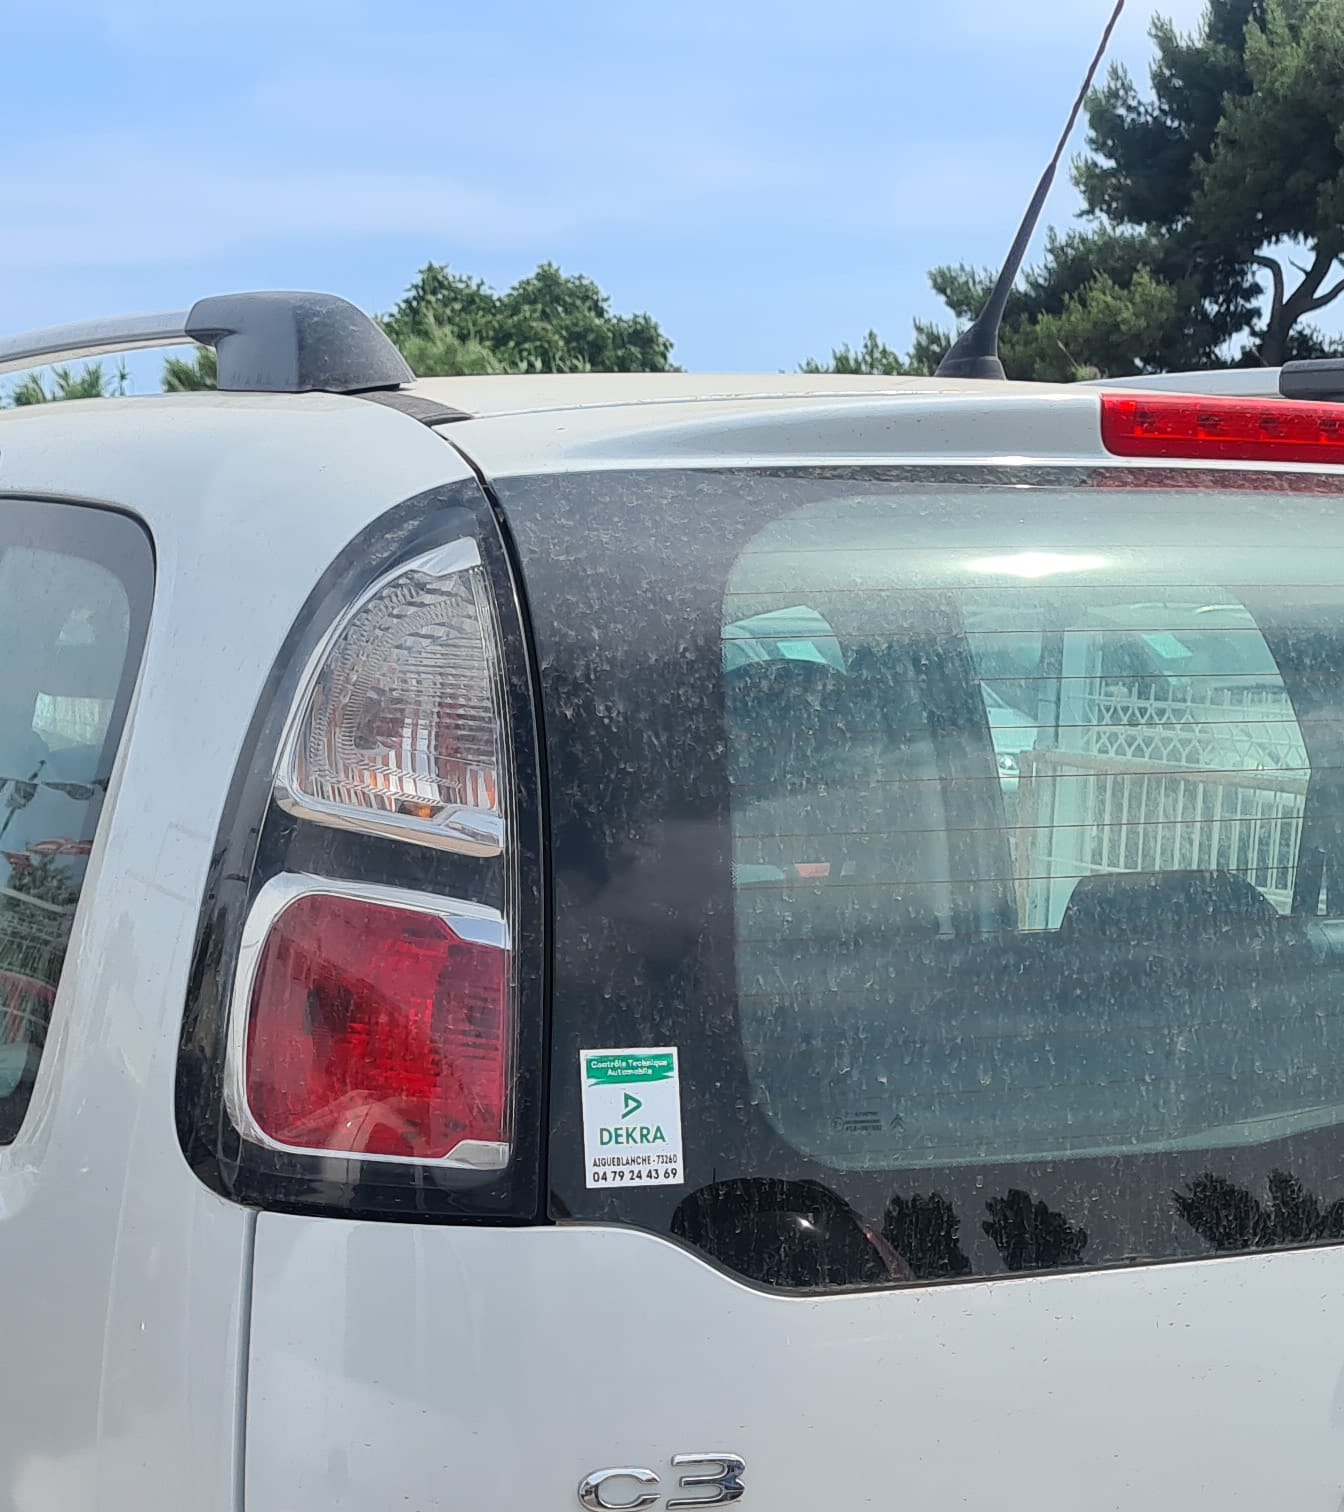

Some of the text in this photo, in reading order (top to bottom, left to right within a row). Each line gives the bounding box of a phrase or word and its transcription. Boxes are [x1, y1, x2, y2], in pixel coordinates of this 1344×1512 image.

[591, 1058, 668, 1069] Contrôle Technique
[607, 1068, 653, 1076] Automobile
[599, 1125, 666, 1146] DEKRA
[592, 1167, 678, 1183] 04 79 24 43 69
